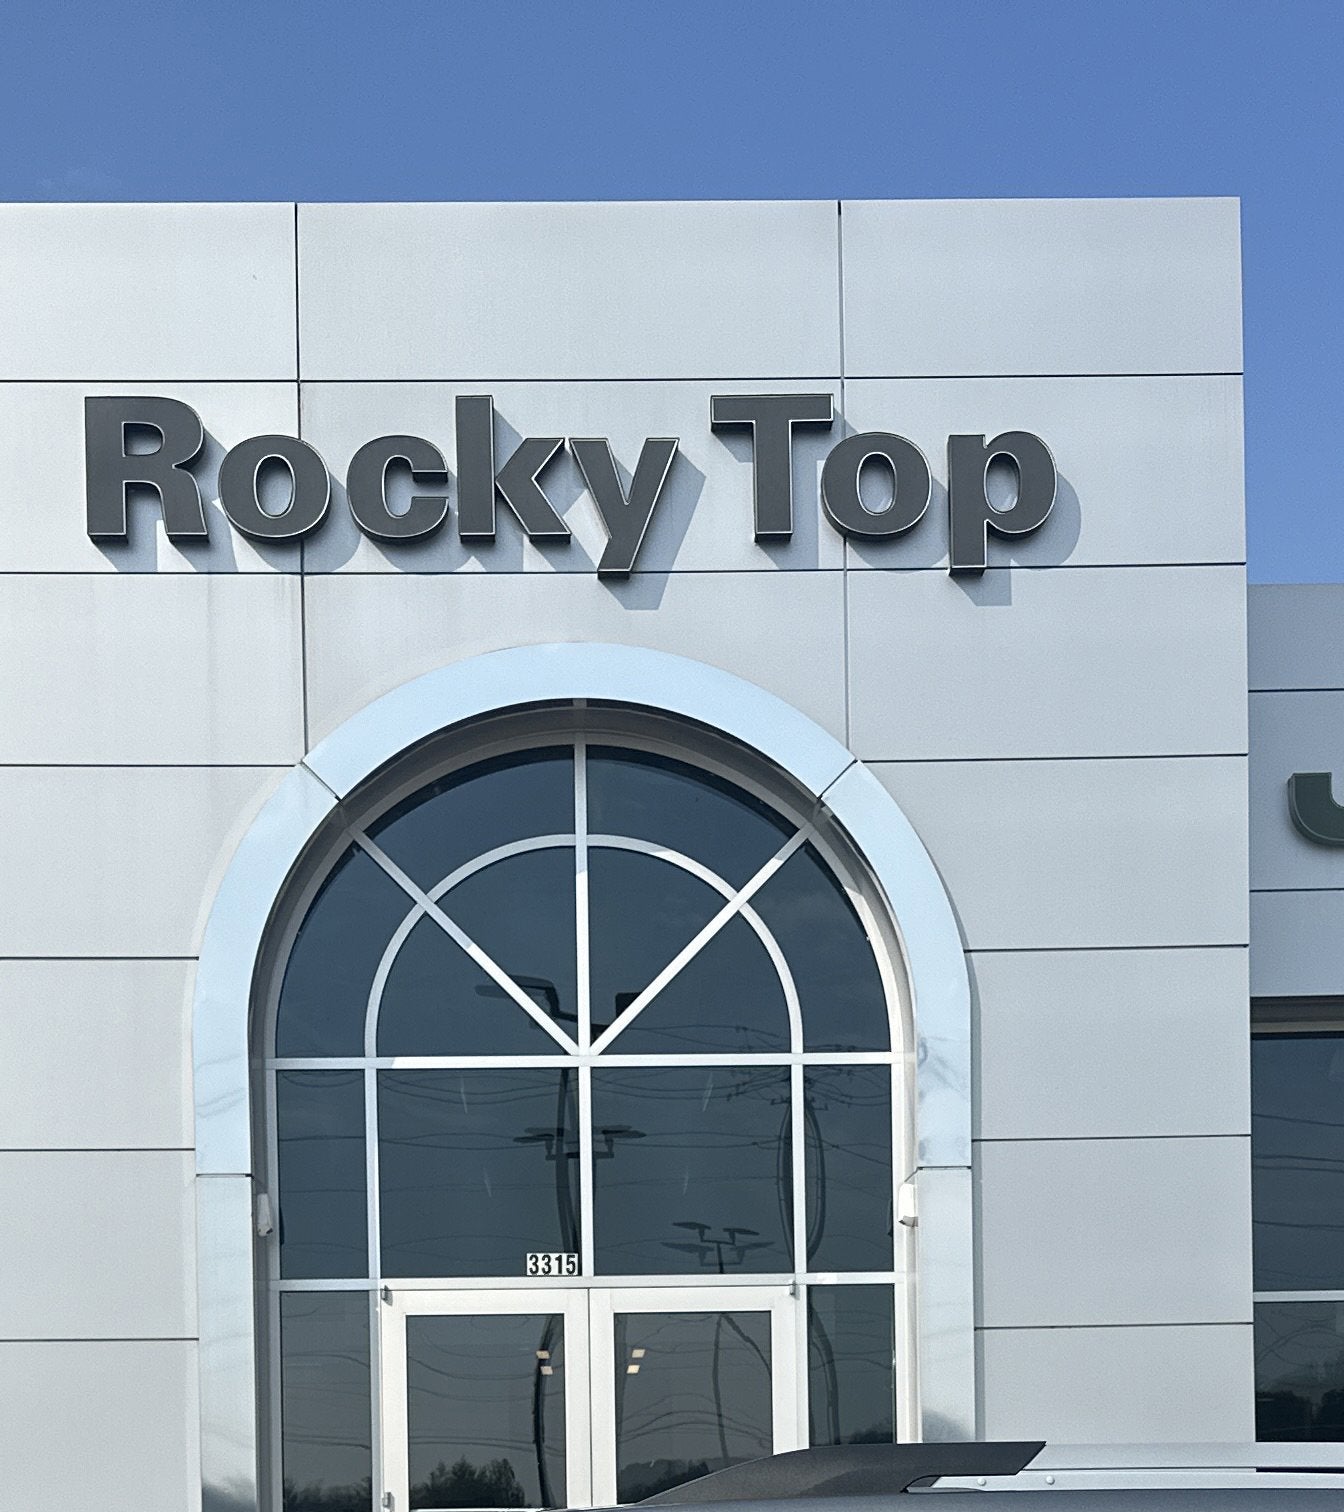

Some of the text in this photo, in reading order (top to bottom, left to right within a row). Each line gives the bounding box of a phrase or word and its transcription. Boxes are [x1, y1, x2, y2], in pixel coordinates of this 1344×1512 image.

[84, 392, 1058, 580] Rocky Top
[528, 1254, 577, 1275] 3315
